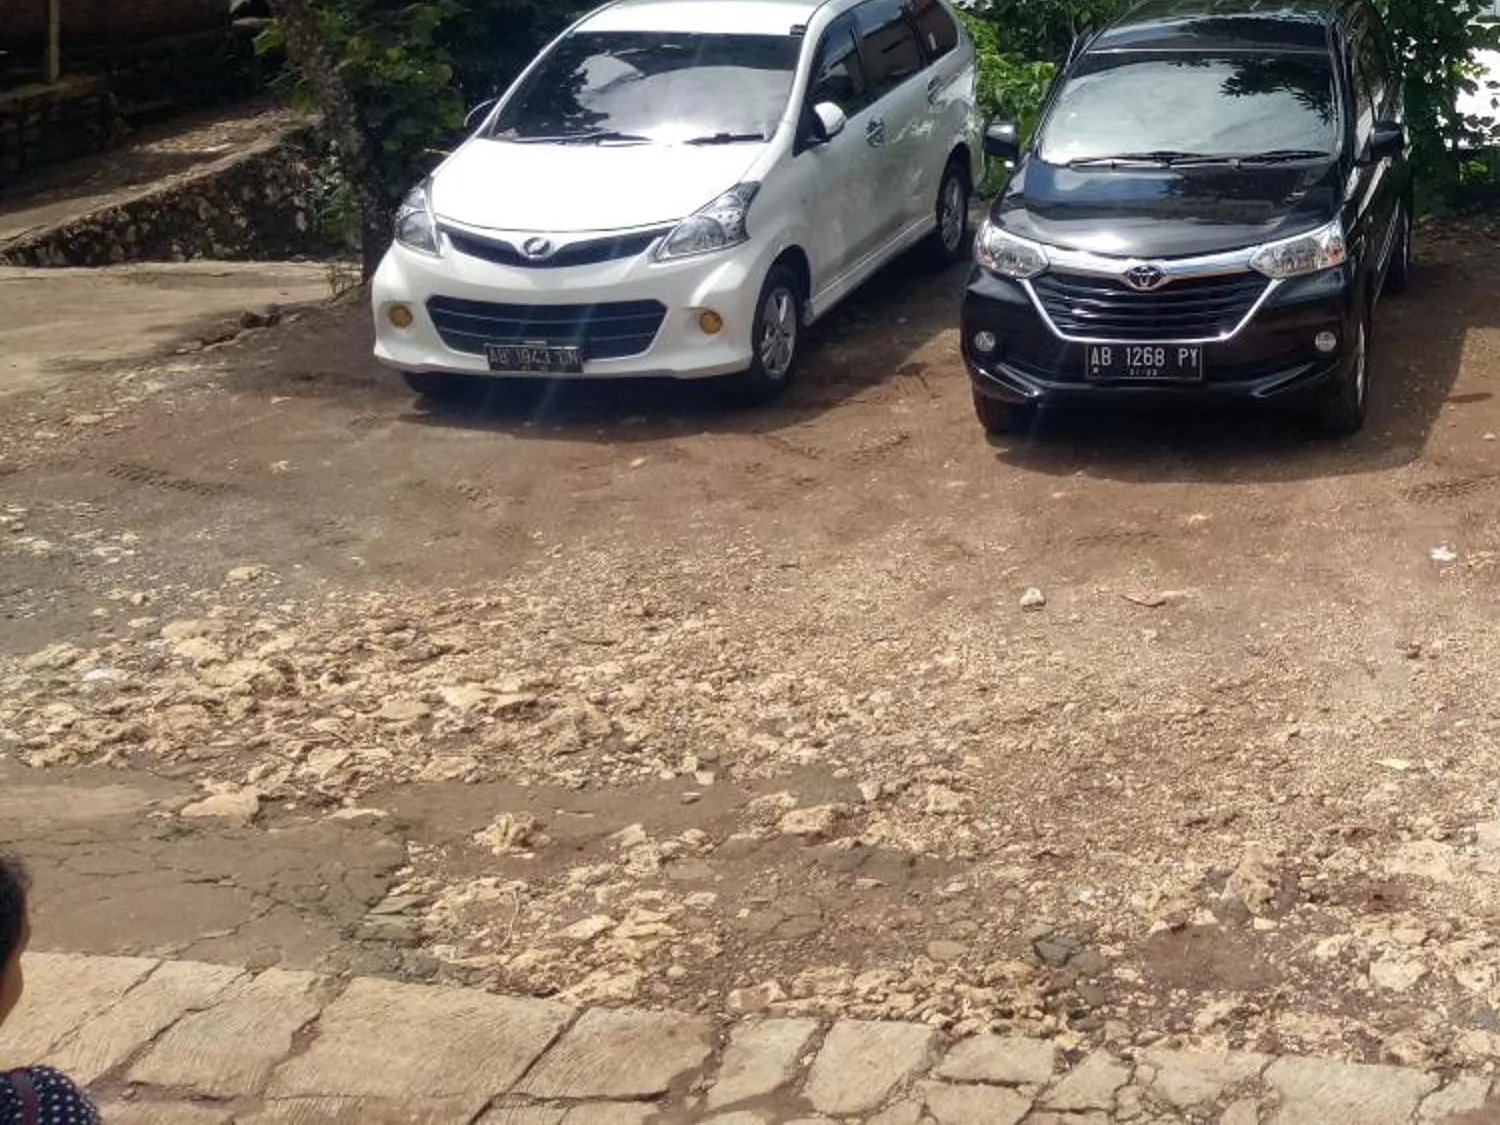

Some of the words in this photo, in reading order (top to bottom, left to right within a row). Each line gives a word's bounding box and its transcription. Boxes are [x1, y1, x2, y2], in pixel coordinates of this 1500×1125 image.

[1091, 346, 1112, 366] AB
[1126, 346, 1165, 367] 1268
[1178, 347, 1198, 367] PY
